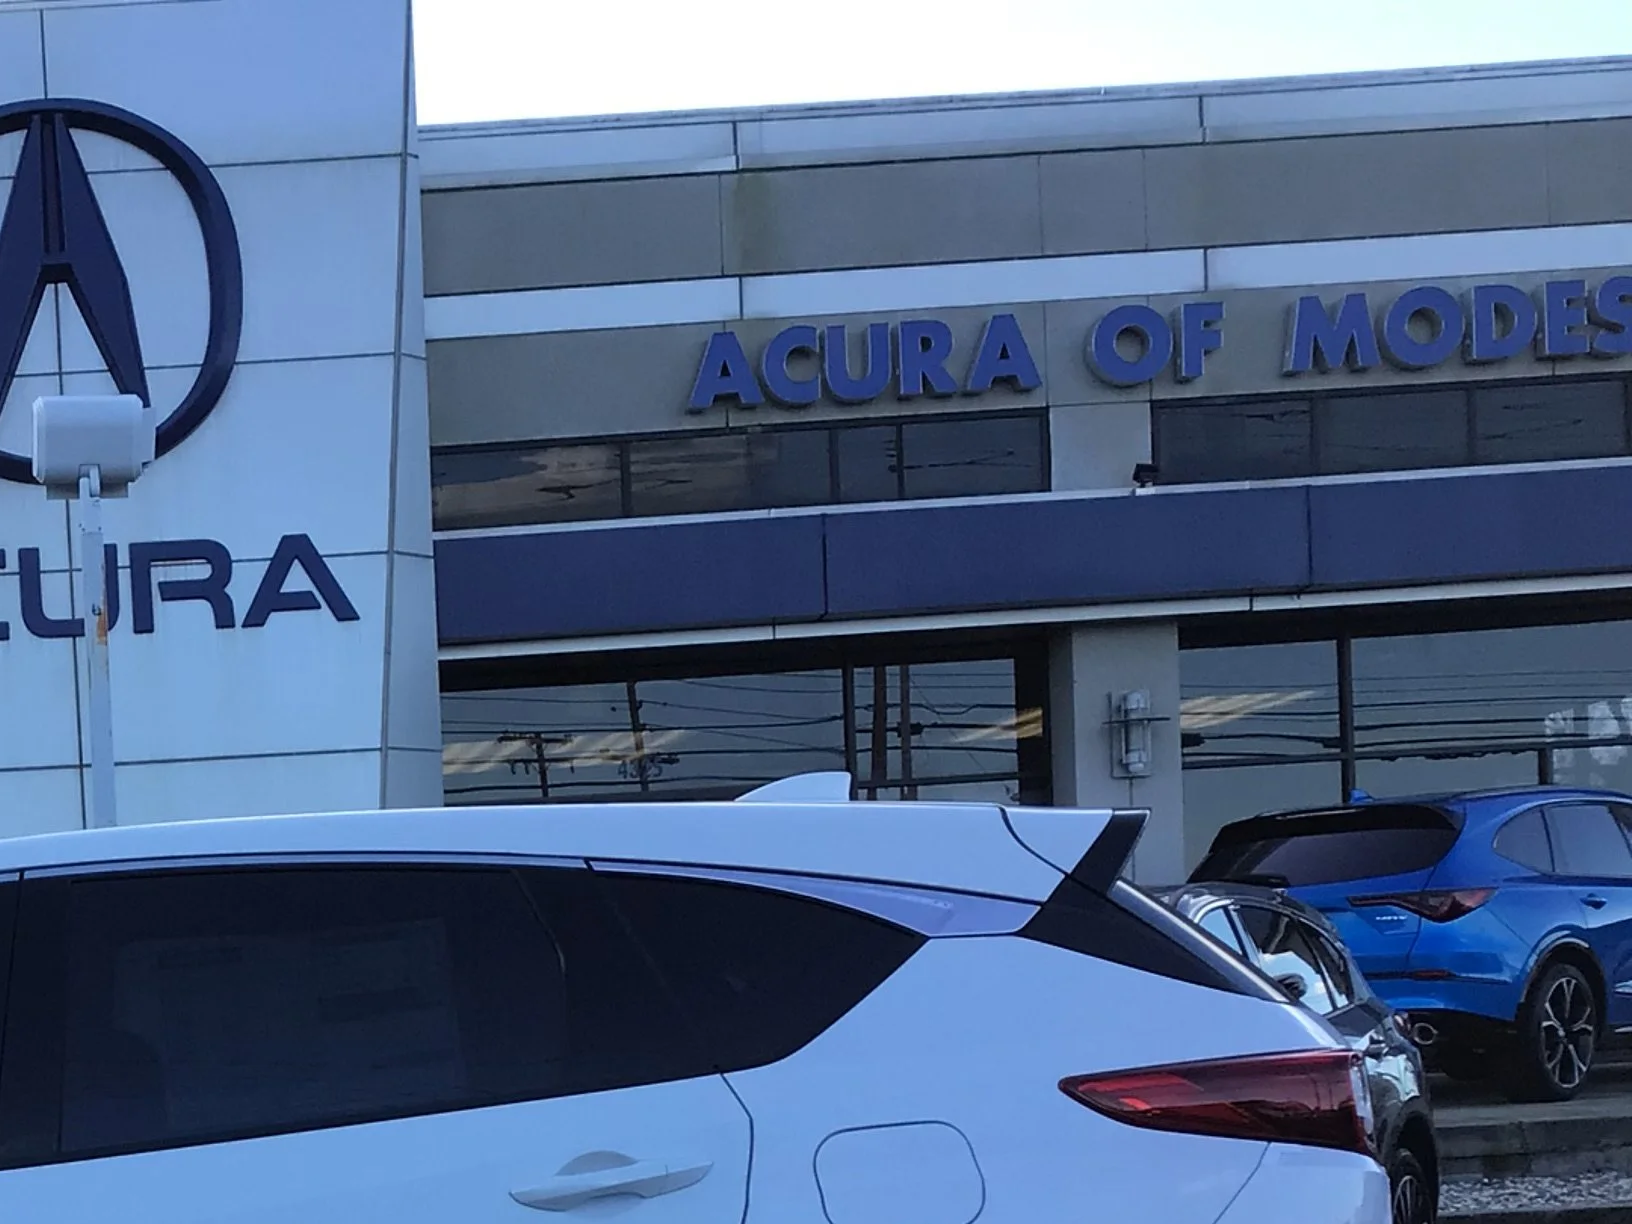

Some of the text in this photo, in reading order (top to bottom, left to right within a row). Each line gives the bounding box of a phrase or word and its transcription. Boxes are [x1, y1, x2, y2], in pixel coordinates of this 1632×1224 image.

[686, 275, 1632, 412] ACURA OF MODES
